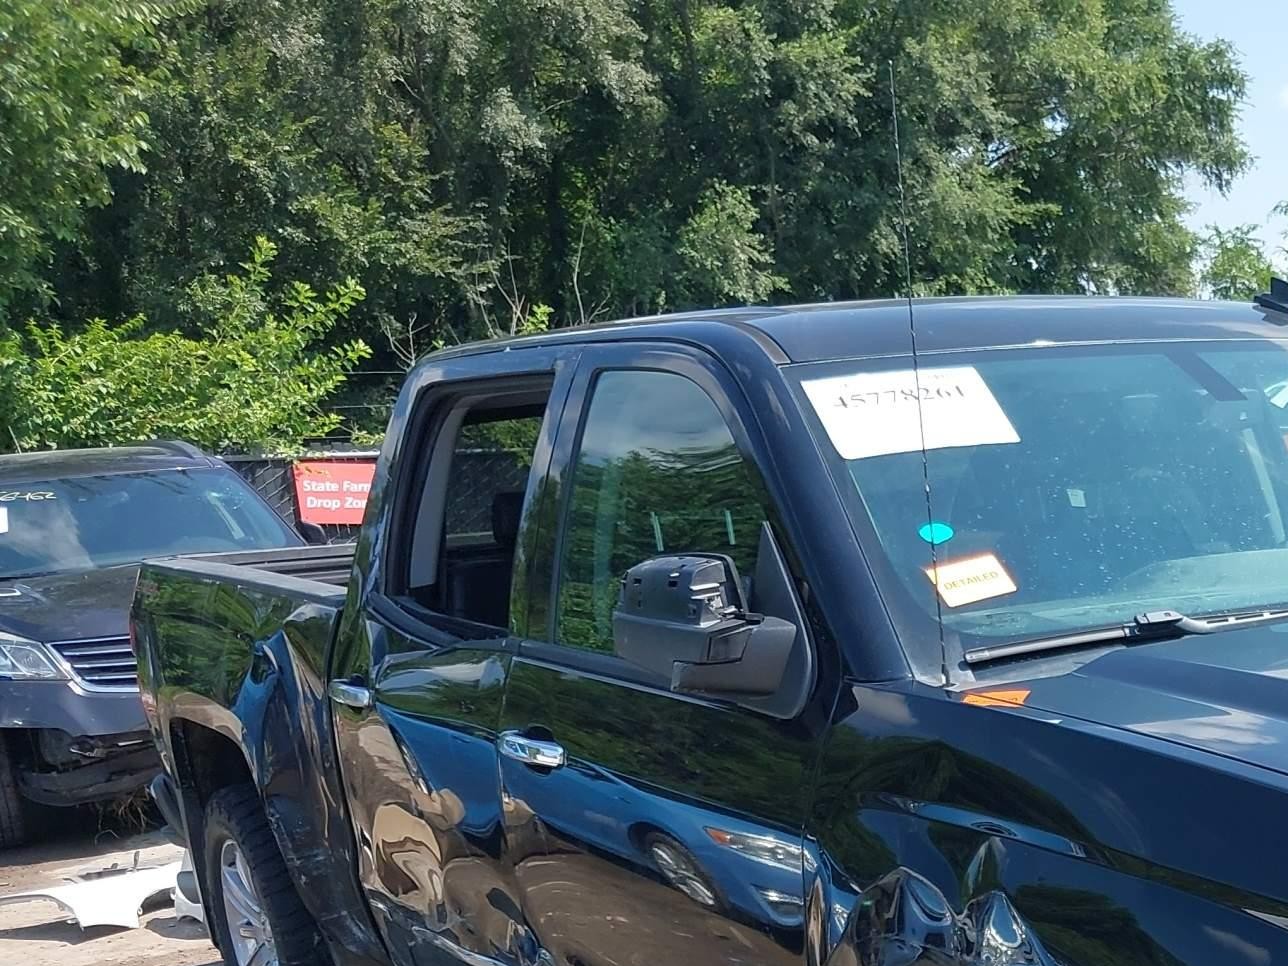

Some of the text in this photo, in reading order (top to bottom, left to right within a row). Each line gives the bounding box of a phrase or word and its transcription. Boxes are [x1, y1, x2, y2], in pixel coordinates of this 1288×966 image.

[303, 480, 340, 492] State
[307, 496, 341, 511] Drop
[943, 570, 1000, 591] DETAILED
